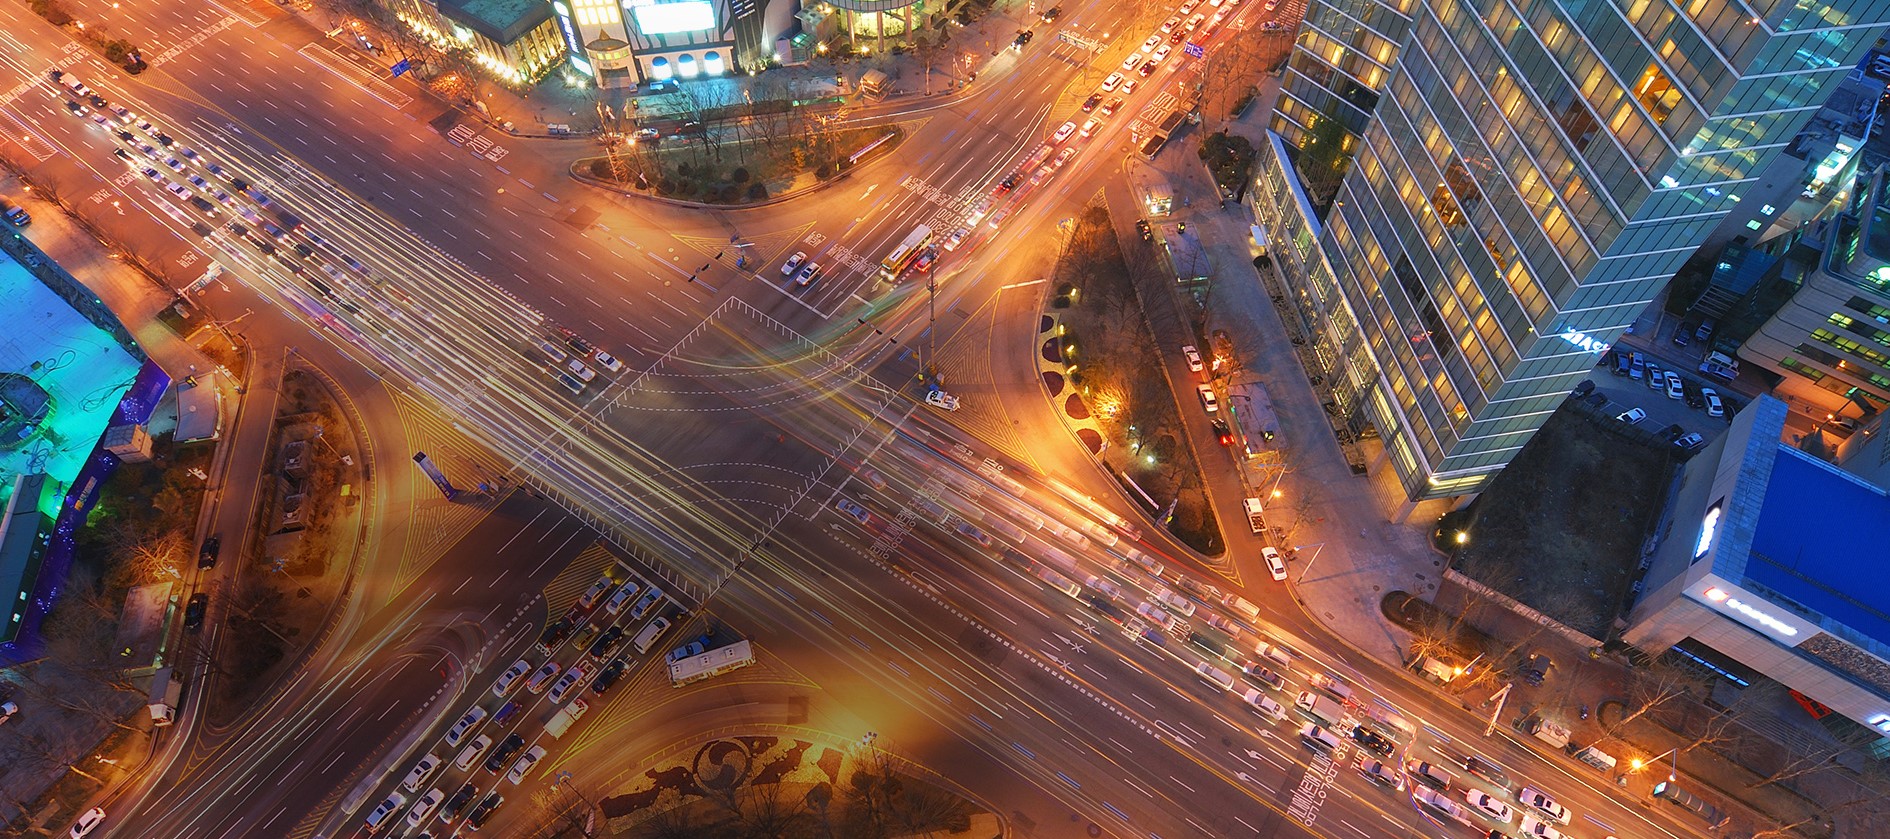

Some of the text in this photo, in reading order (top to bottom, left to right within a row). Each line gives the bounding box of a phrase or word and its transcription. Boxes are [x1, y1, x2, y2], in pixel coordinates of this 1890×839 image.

[1153, 91, 1179, 112] 0700
[1139, 104, 1167, 125] 2100
[447, 123, 476, 143] 0700
[466, 134, 494, 154] 2100
[936, 208, 961, 226] 0700
[802, 230, 827, 248] 선릉역
[176, 250, 199, 269] 선릉역
[841, 251, 865, 270] 선릉역
[1308, 750, 1341, 784] 강남역
[1297, 772, 1328, 806] 선릉역
[1286, 794, 1317, 827] 강남역
